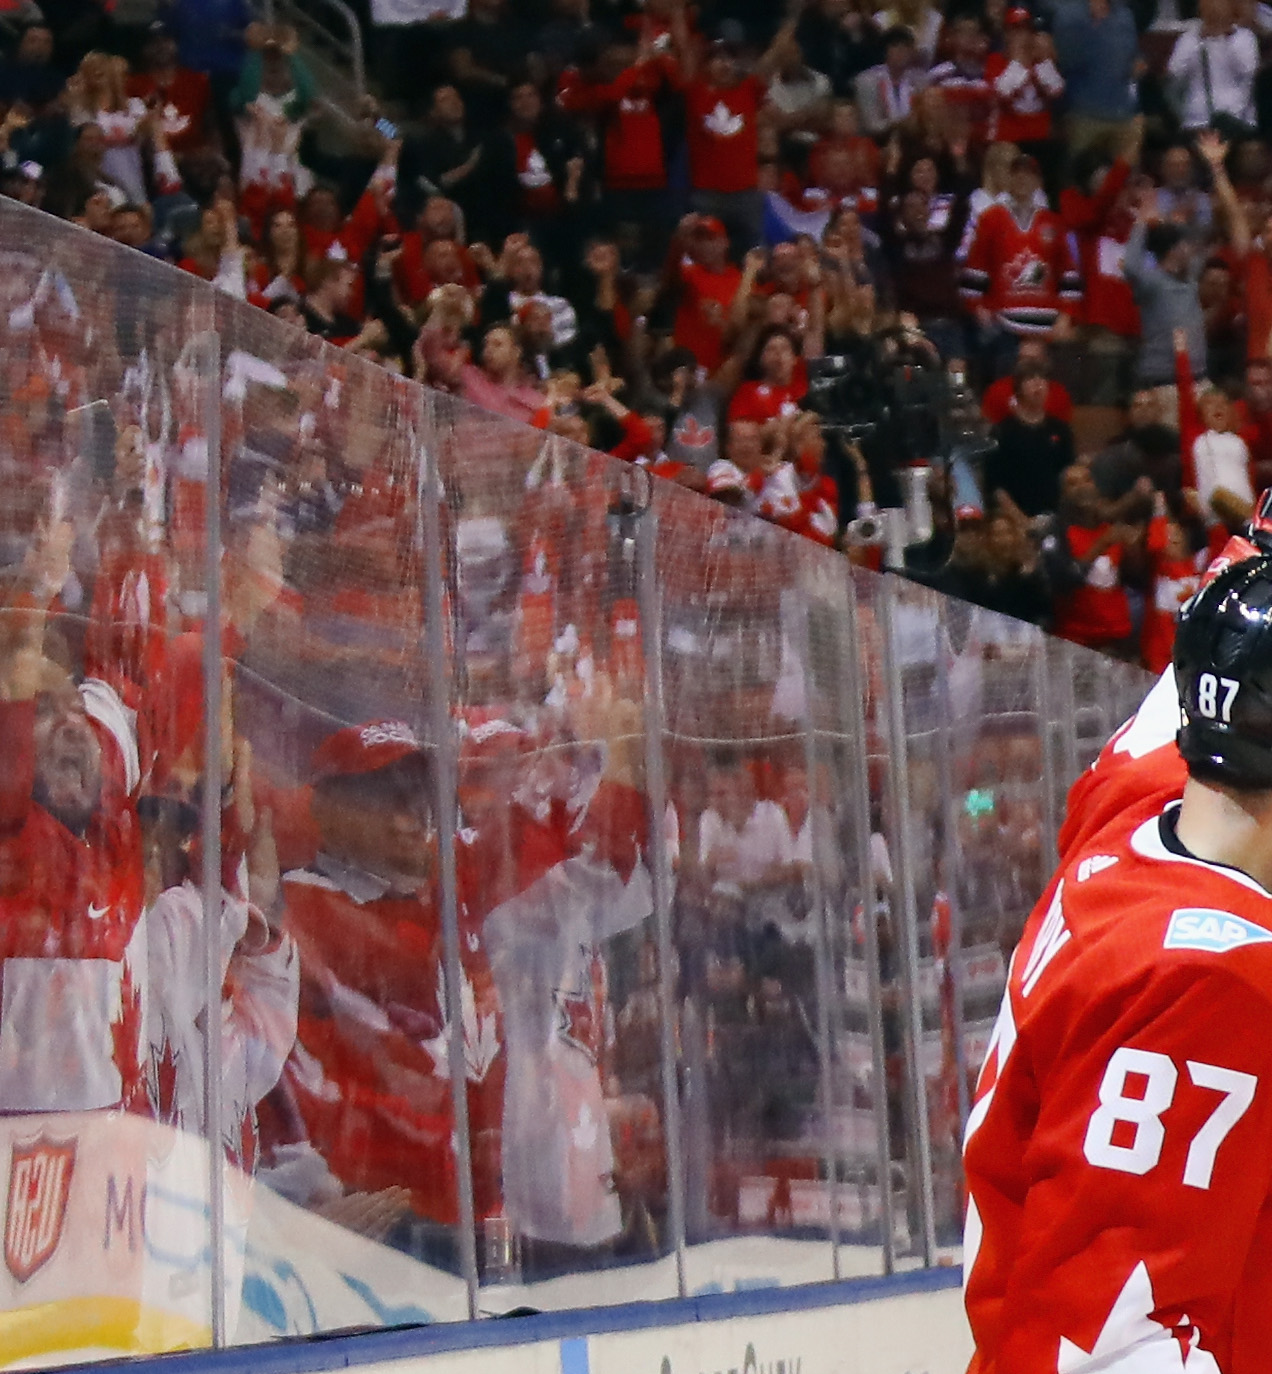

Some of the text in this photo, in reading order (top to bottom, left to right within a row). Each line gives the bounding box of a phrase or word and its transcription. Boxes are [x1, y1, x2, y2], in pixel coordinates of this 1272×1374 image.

[1199, 672, 1240, 723] 87
[1173, 915, 1248, 943] SAP
[1084, 1046, 1258, 1191] 87
